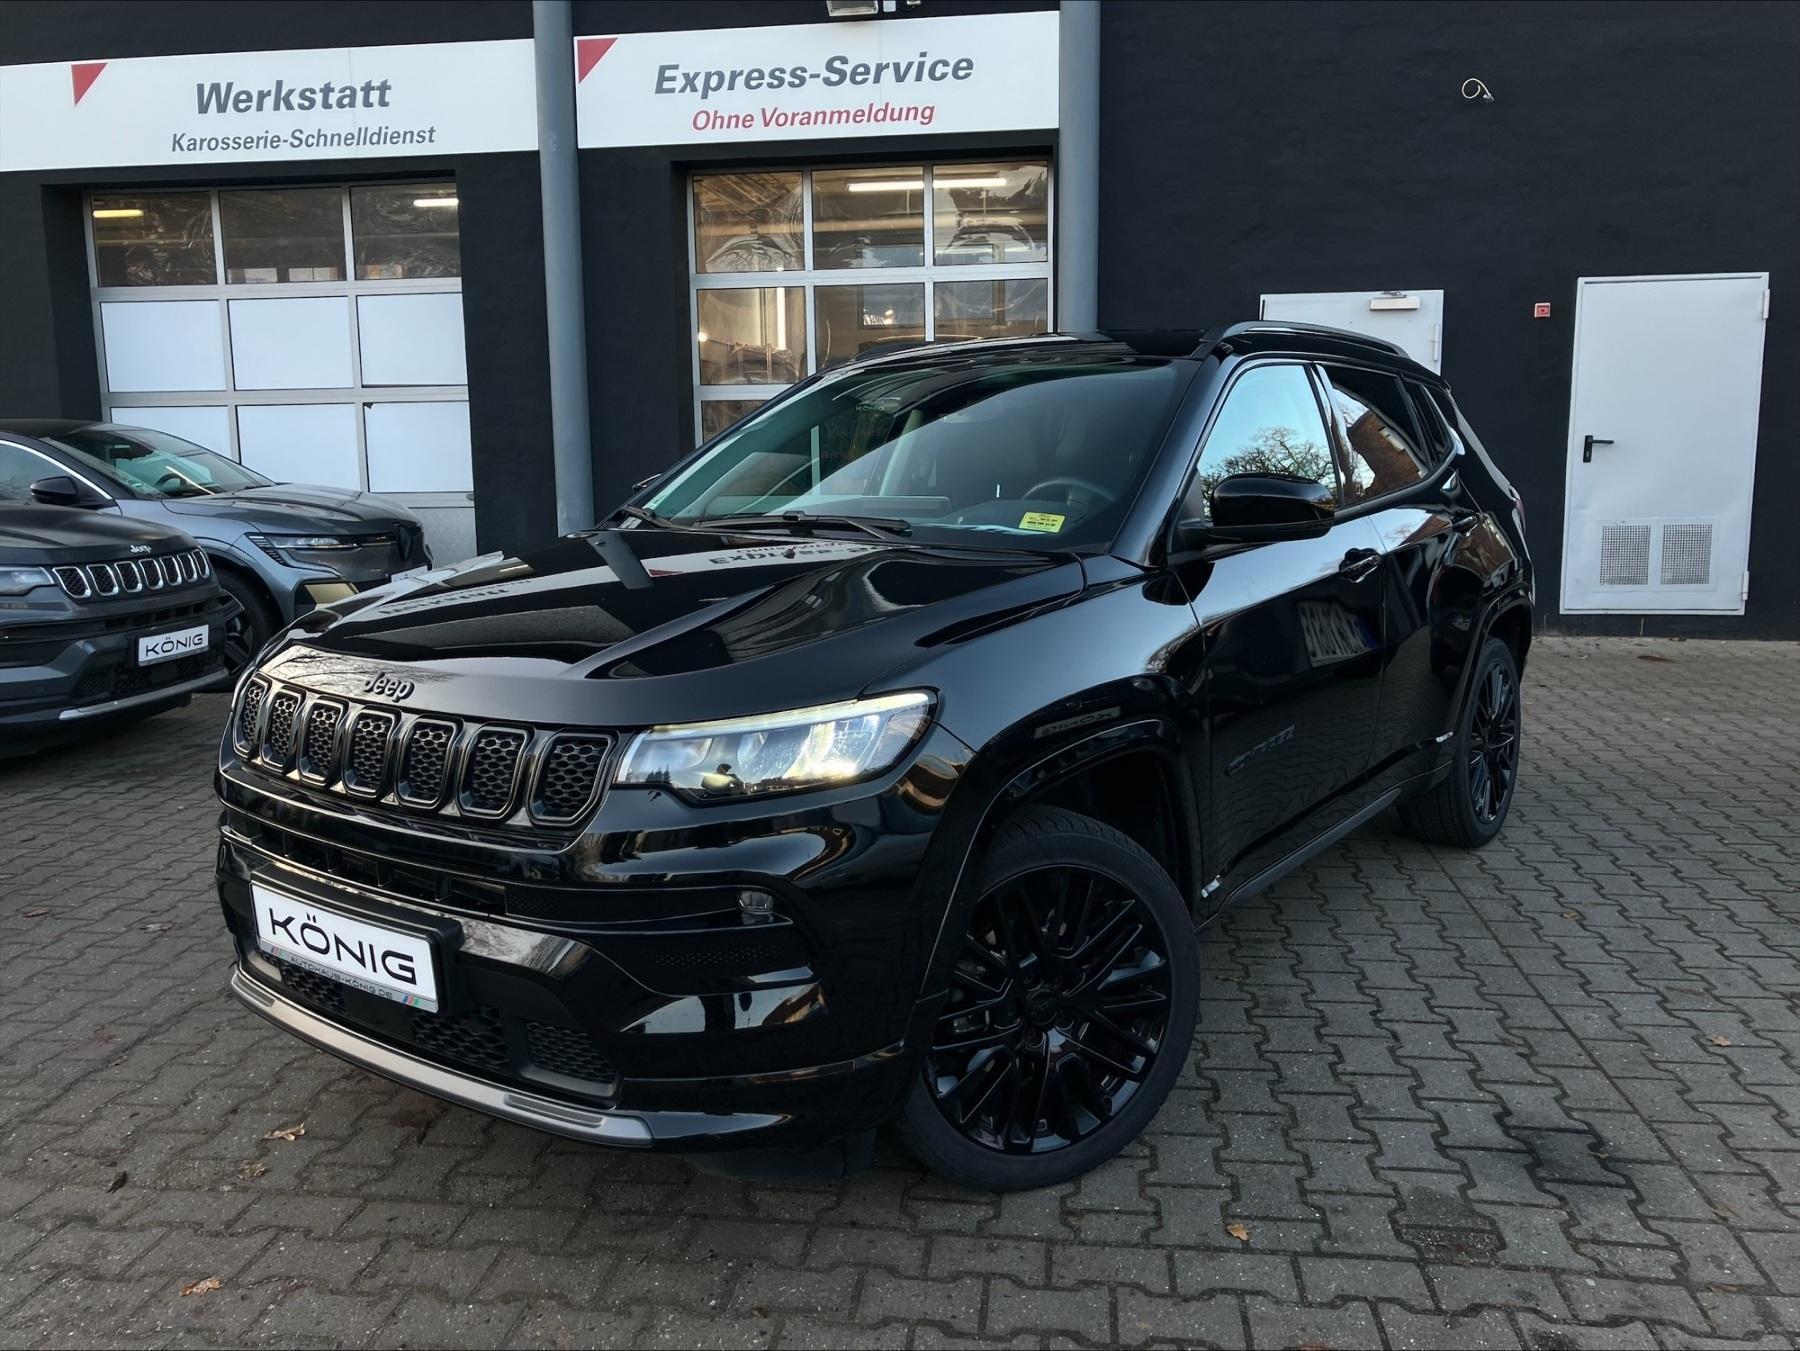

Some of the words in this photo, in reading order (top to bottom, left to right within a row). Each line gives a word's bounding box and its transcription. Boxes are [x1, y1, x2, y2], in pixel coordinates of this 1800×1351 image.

[654, 51, 974, 99] Express-Service
[196, 79, 392, 115] Werkstatt
[692, 109, 755, 131] Ohne
[760, 101, 936, 128] Voranmeldung
[171, 125, 436, 153] Karosserie-Schnelldienst
[130, 544, 151, 554] Jeep
[145, 633, 204, 657] KÖNIG
[363, 671, 416, 703] Jeep
[268, 907, 418, 986] KÖNIG
